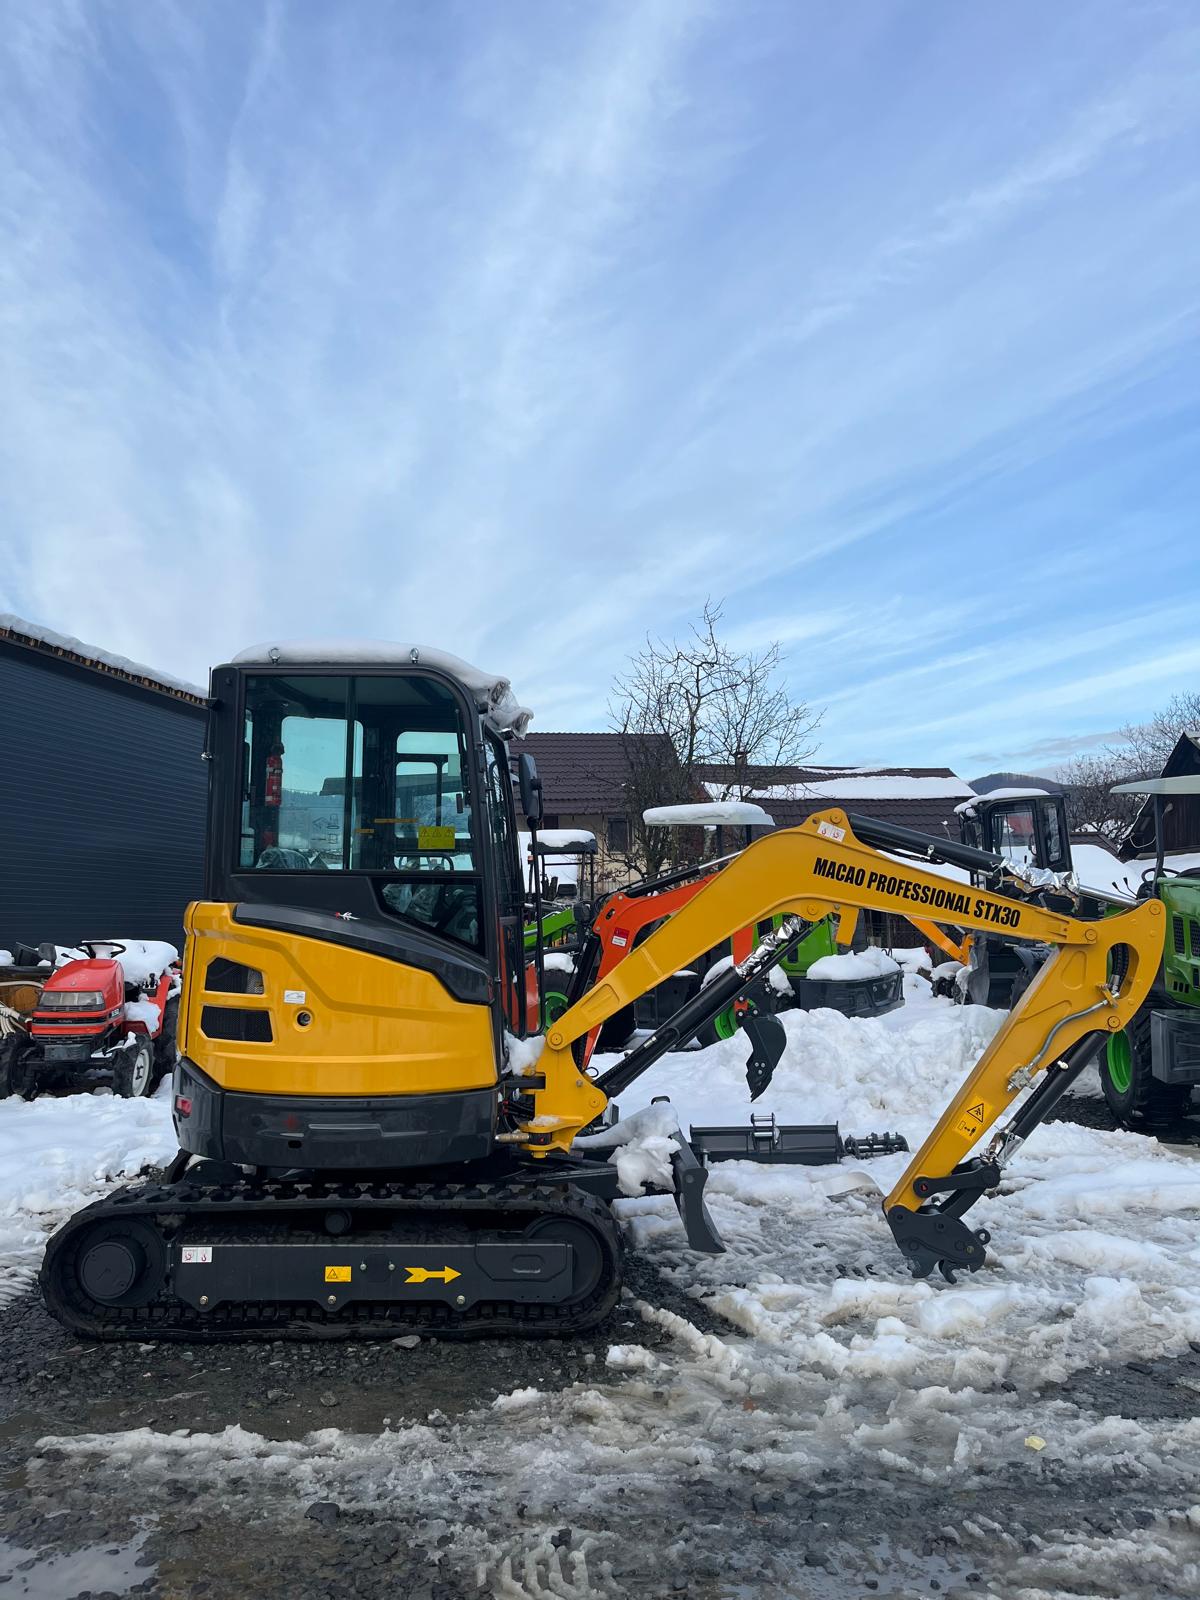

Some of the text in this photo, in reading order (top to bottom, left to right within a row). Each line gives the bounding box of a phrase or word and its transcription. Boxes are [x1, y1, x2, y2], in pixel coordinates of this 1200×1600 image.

[813, 857, 1021, 928] MACAO PROFESSIONAL STX30
